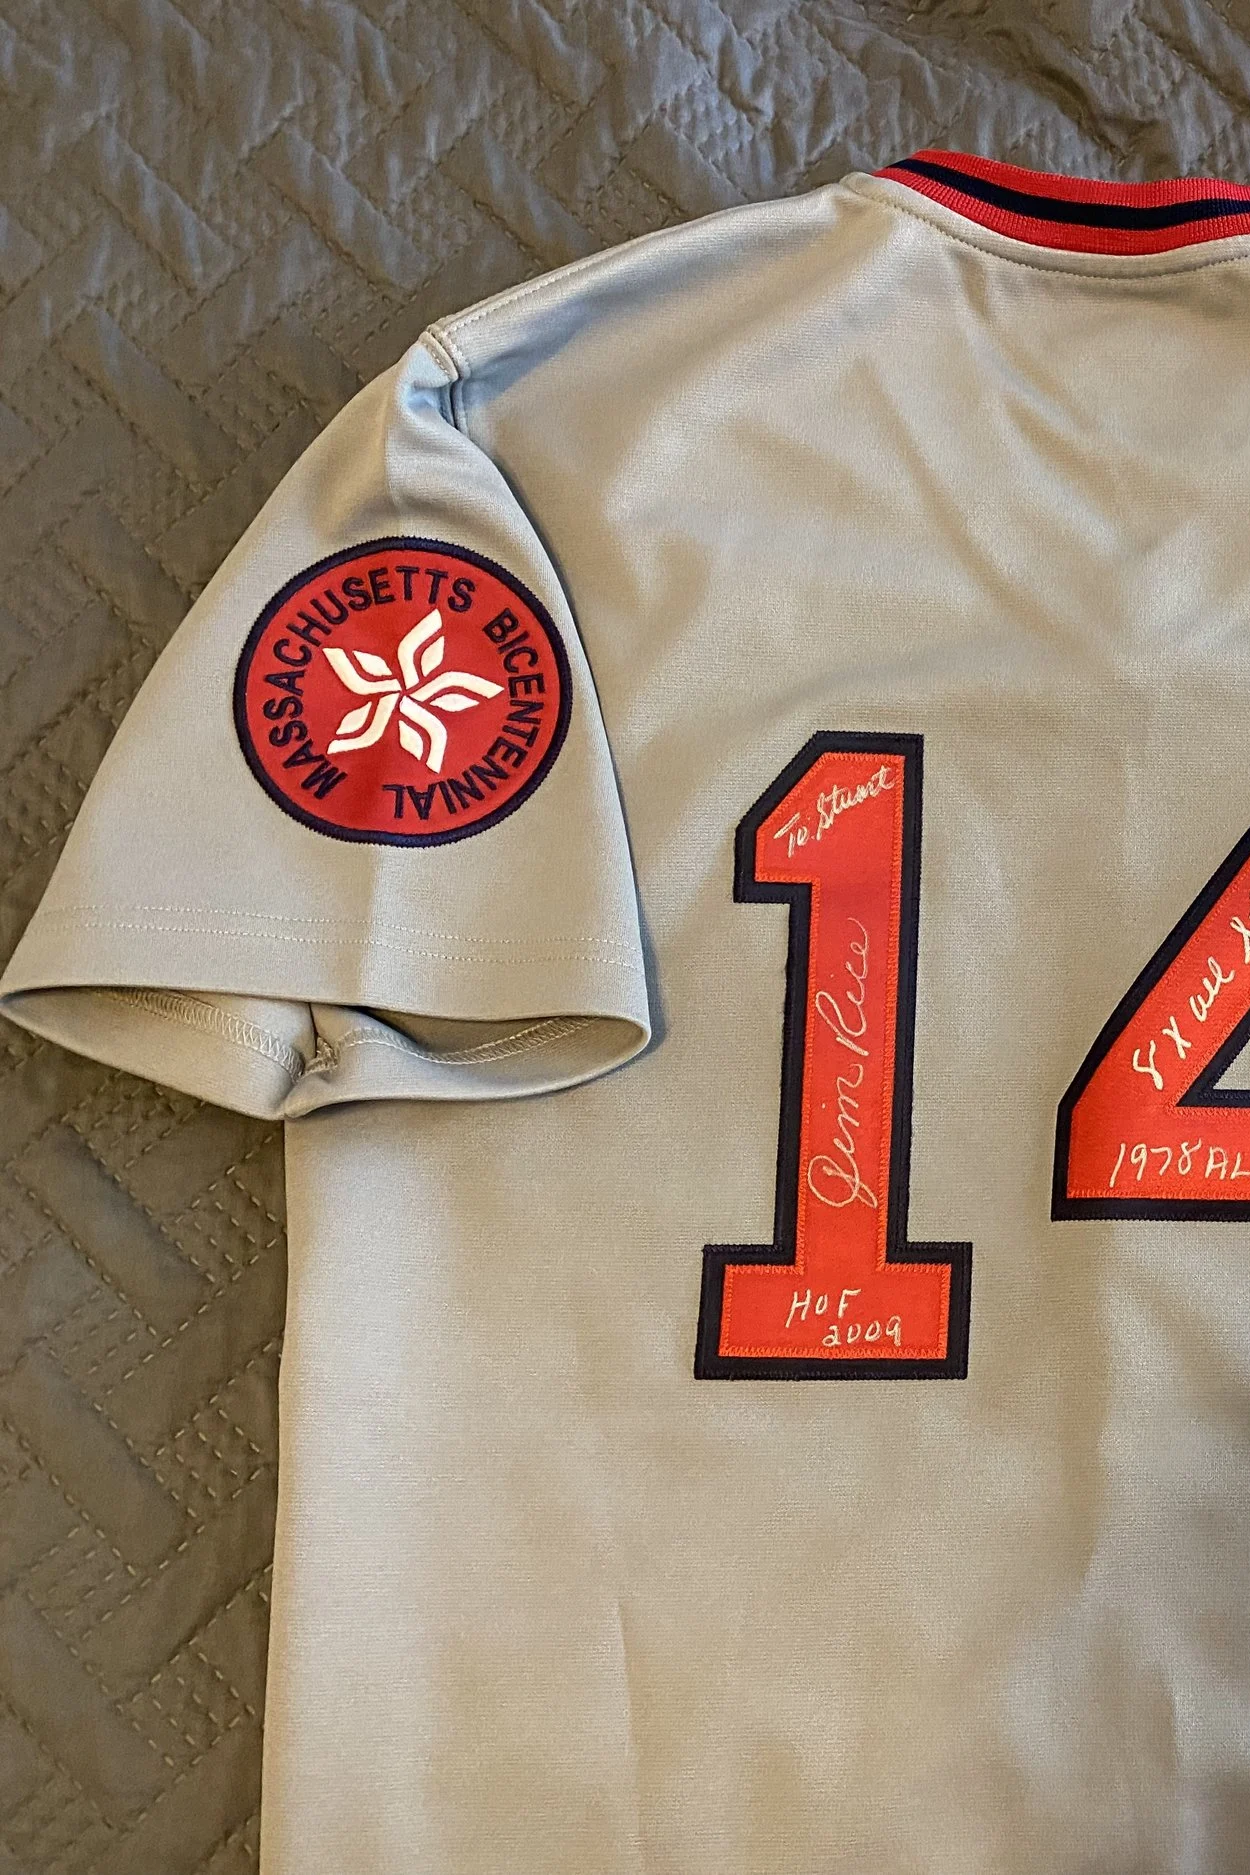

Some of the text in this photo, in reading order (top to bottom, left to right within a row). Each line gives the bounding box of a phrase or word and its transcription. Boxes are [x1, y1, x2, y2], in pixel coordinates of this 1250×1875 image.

[263, 566, 546, 820] MASSACHUSETTS BICENTENNIAL
[822, 1315, 902, 1348] 2009
